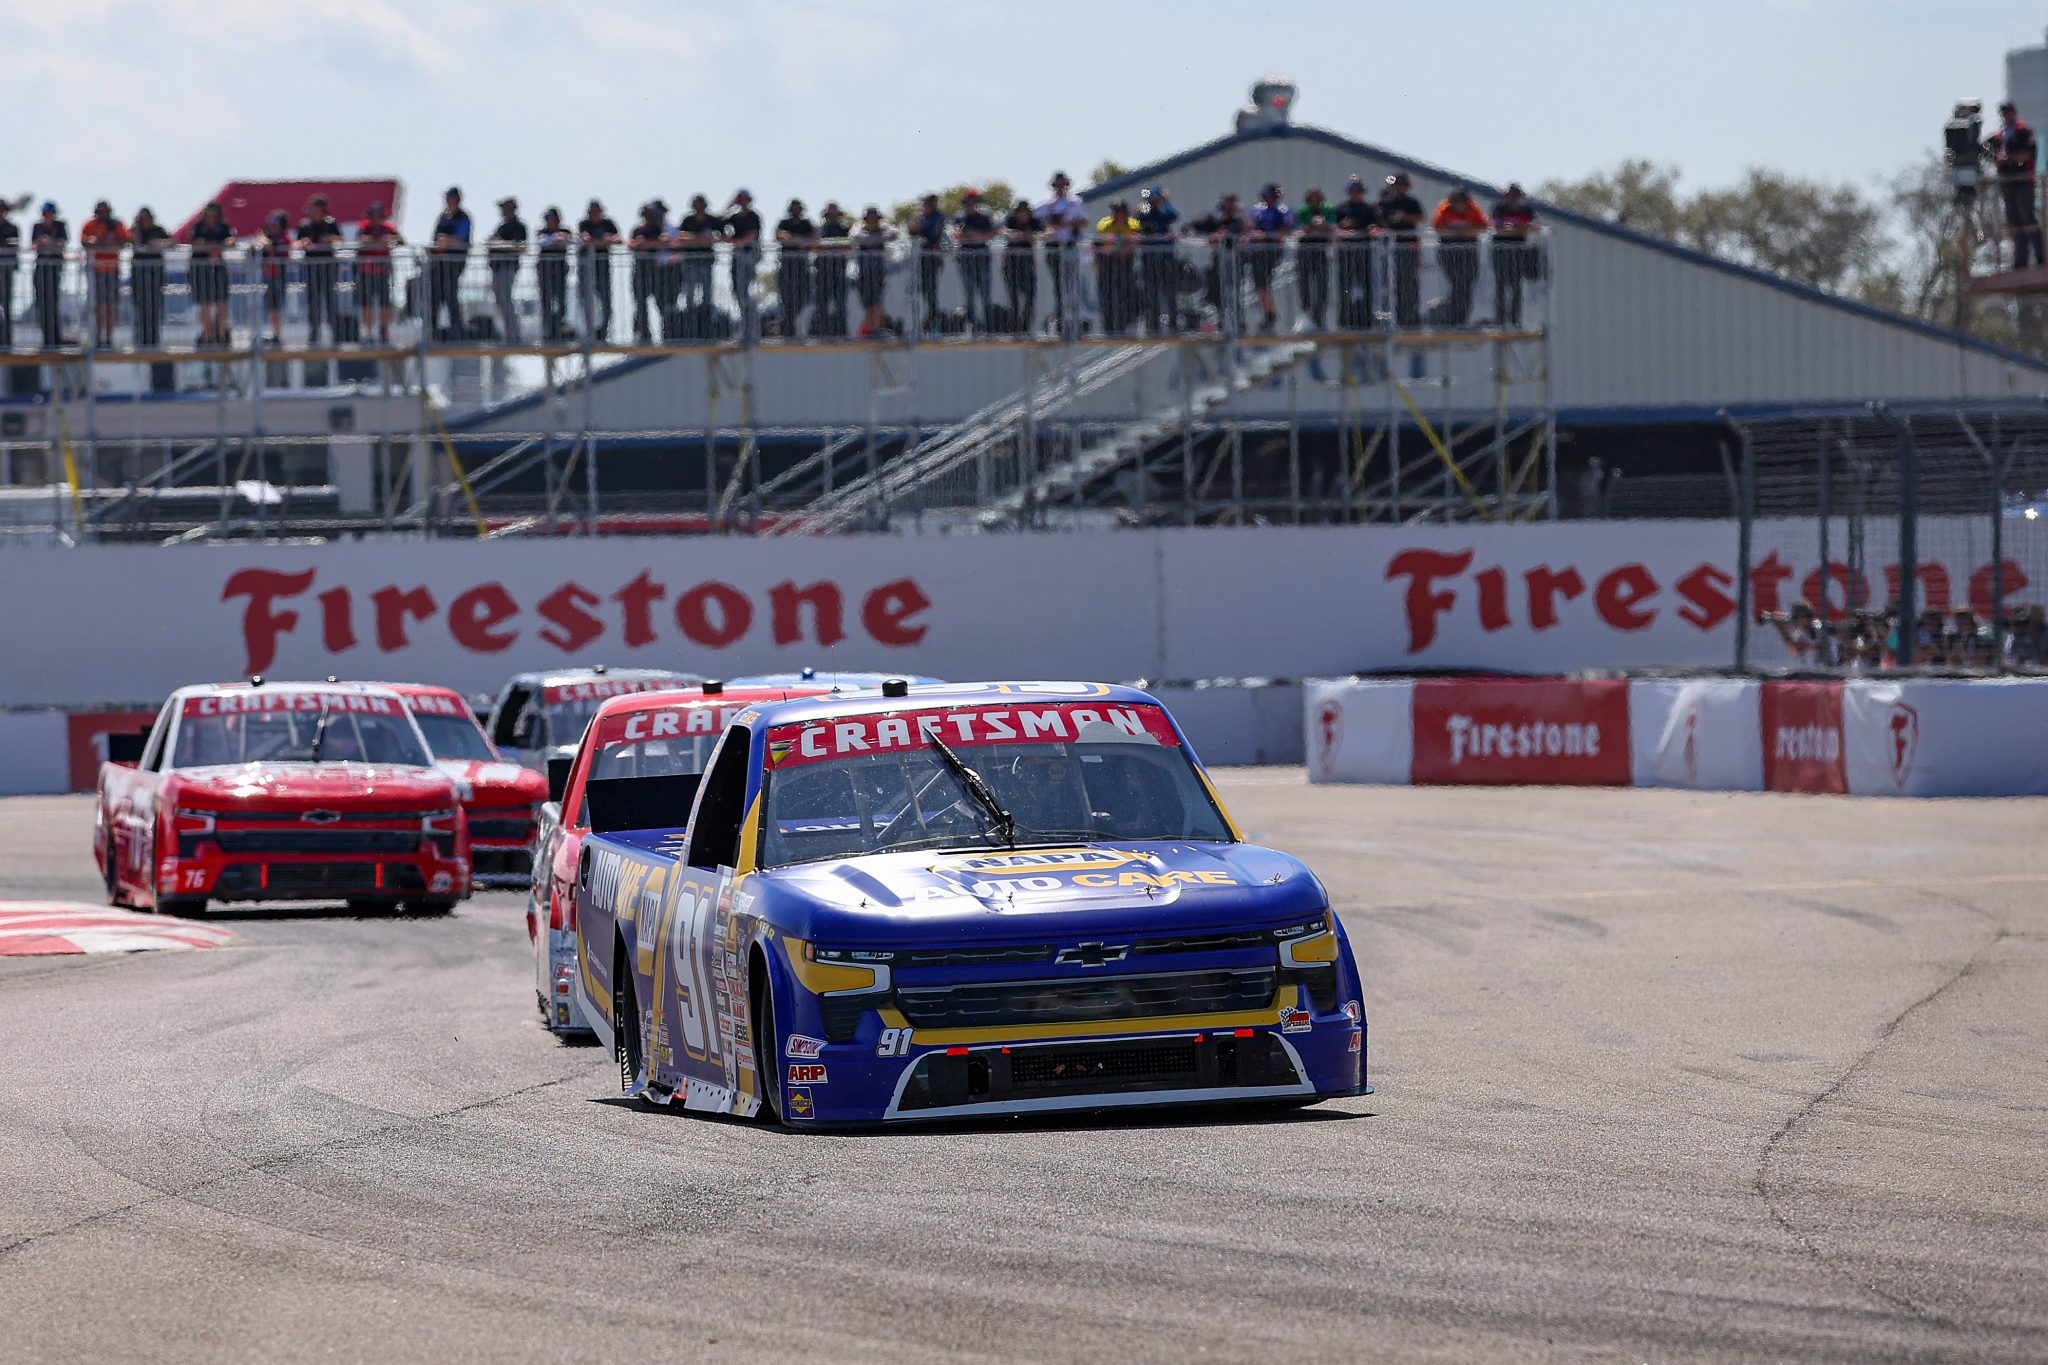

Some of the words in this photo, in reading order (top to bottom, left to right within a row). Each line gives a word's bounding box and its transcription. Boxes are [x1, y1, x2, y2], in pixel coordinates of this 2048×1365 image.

[222, 566, 934, 676] Firestone
[1386, 548, 2028, 654] Firestone
[200, 694, 391, 715] CRAFTSMAN
[800, 709, 1145, 758] CRAFTSMAN
[1447, 714, 1600, 764] Firestone
[184, 869, 206, 889] 76
[591, 849, 621, 913] AUTO
[967, 851, 1109, 869] NAPA
[914, 877, 1063, 902] AUTO
[1072, 871, 1237, 887] CARE
[638, 895, 658, 945] NAPA
[673, 888, 720, 1060] 91
[878, 1027, 914, 1057] 91
[789, 1065, 825, 1080] ARP
